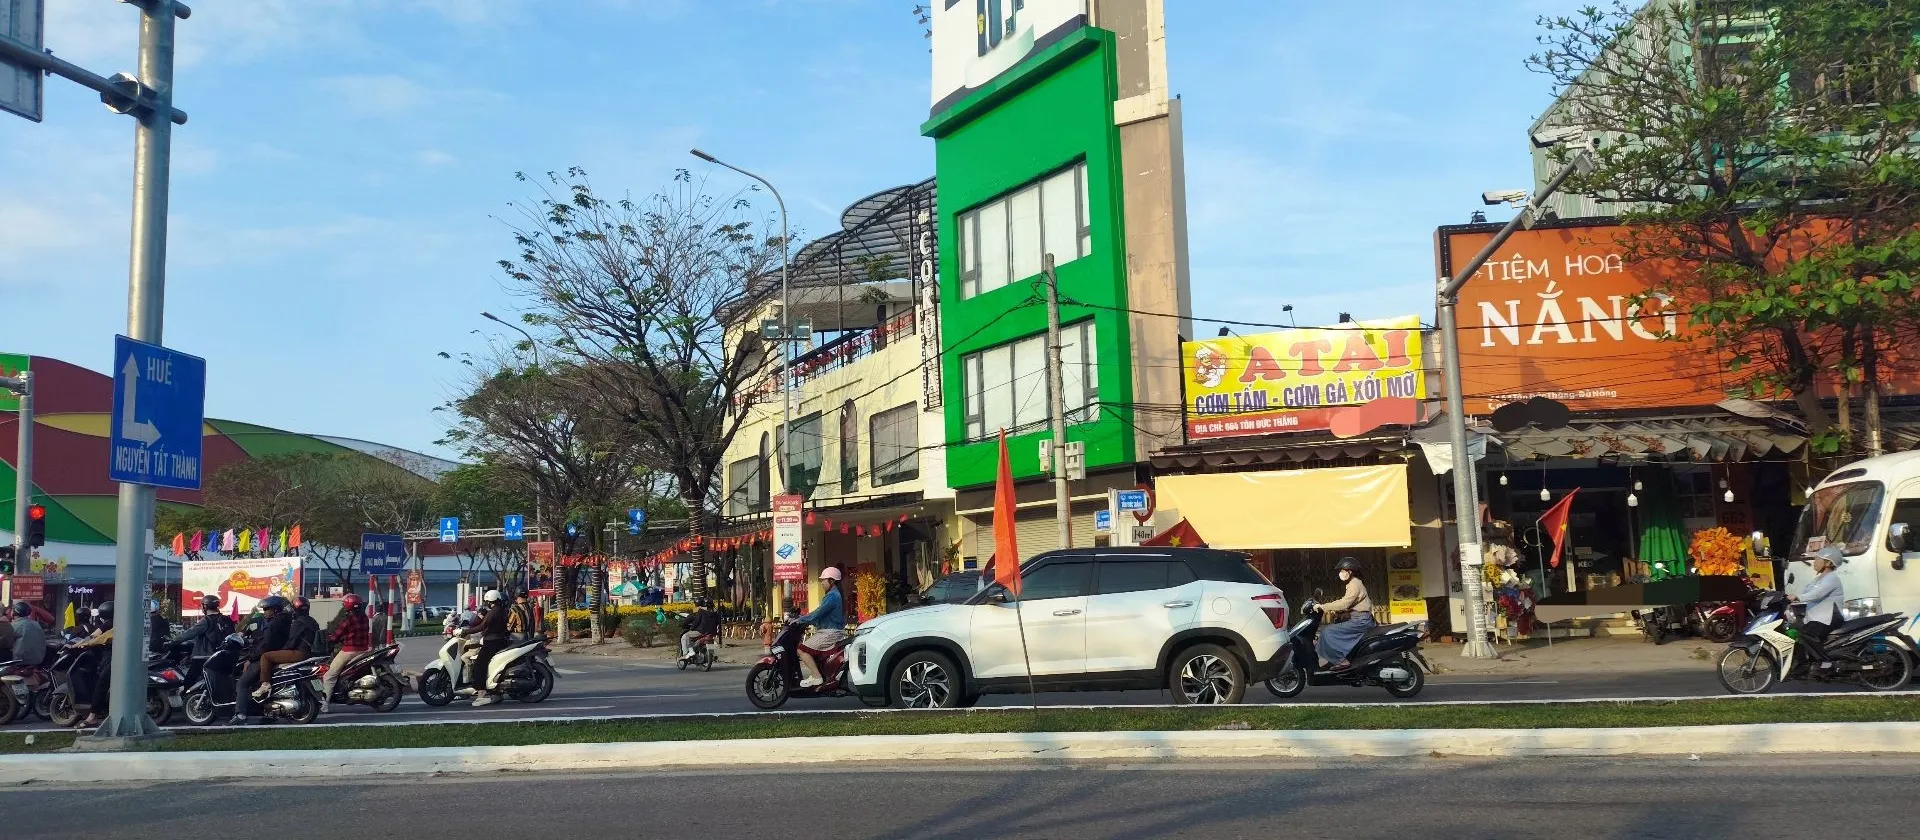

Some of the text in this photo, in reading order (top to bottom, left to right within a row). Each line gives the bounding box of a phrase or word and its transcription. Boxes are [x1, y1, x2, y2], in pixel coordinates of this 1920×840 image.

[1483, 253, 1622, 283] TIỆM HOA
[1477, 280, 1676, 347] NẮNG
[147, 353, 172, 385] HUẾ
[1239, 347, 1286, 382] A
[1196, 392, 1229, 415] CƠM
[1234, 384, 1268, 411] TẤM
[1284, 384, 1320, 407] CƠM
[1326, 378, 1348, 403] GÀ
[1353, 372, 1381, 401] XỐI
[1387, 371, 1415, 398] MỠ
[115, 443, 197, 481] NGUYỄN TẤT THÀNH
